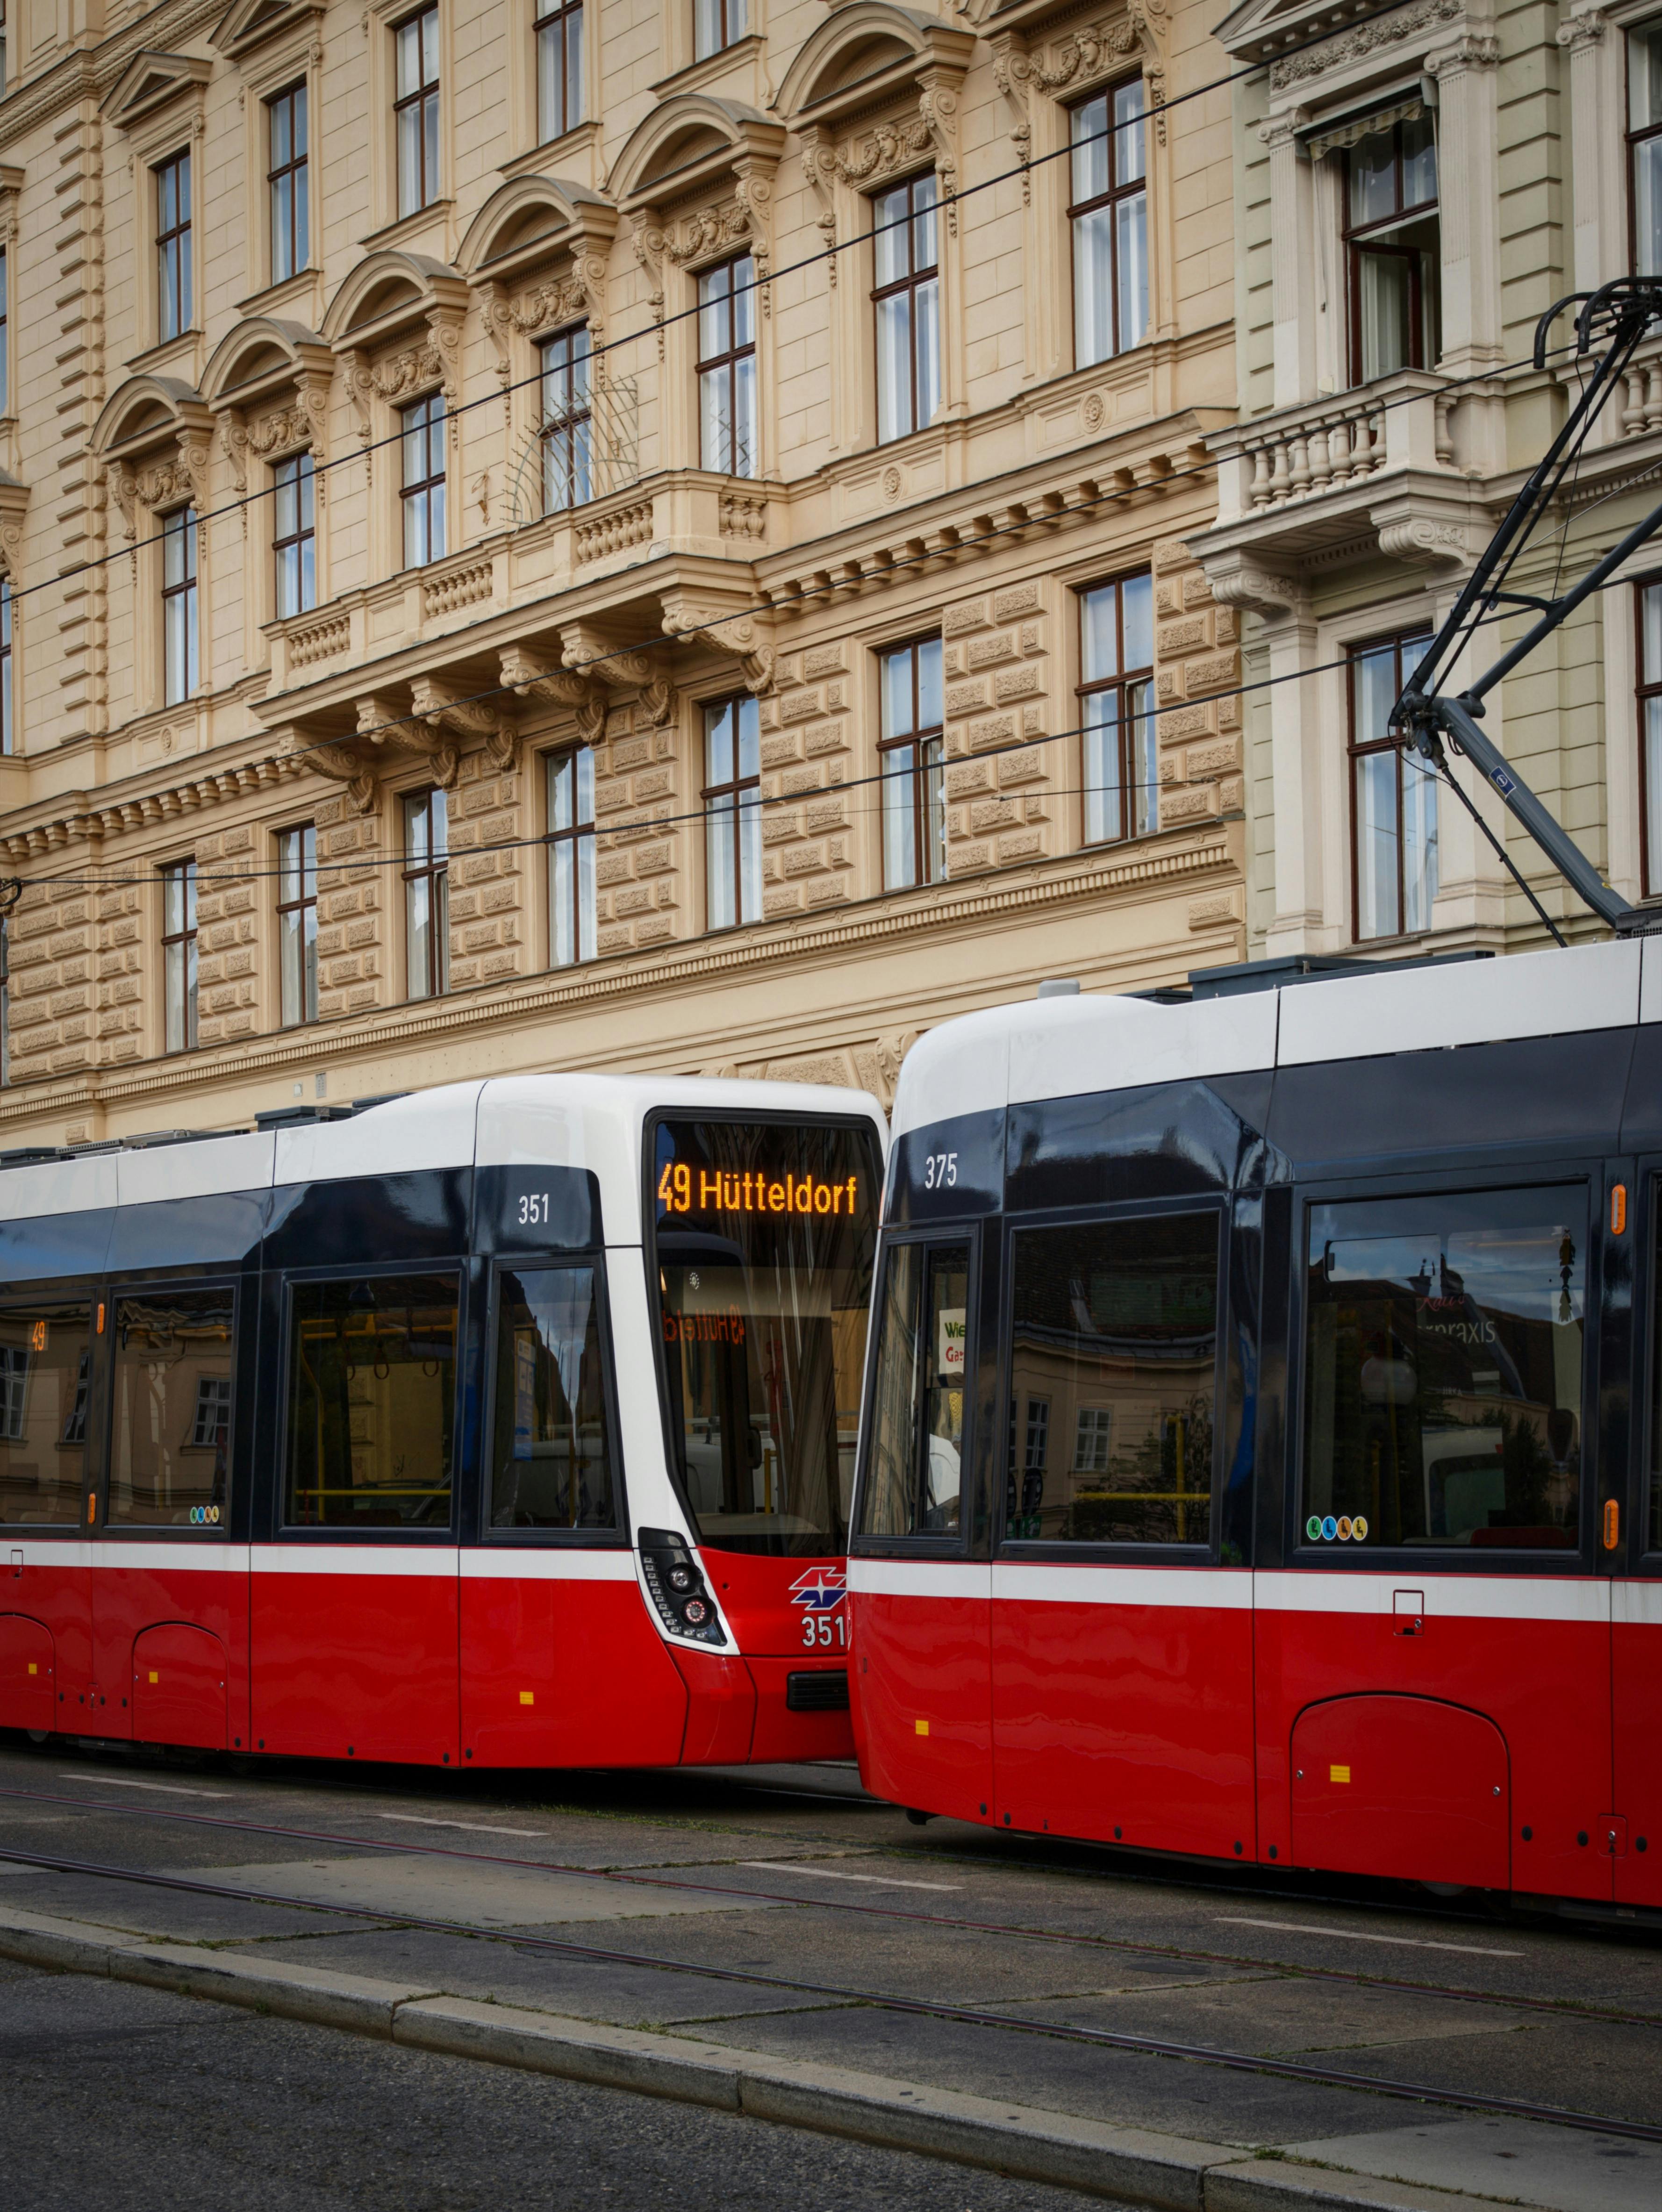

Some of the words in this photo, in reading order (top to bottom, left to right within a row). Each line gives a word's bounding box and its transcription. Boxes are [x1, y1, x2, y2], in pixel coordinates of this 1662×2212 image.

[925, 1152, 958, 1189] 375
[658, 1163, 691, 1212] 49
[700, 1171, 856, 1214] Hütteldorf
[518, 1193, 549, 1224] 351
[32, 1321, 45, 1351] 49
[802, 1616, 845, 1646] 351
